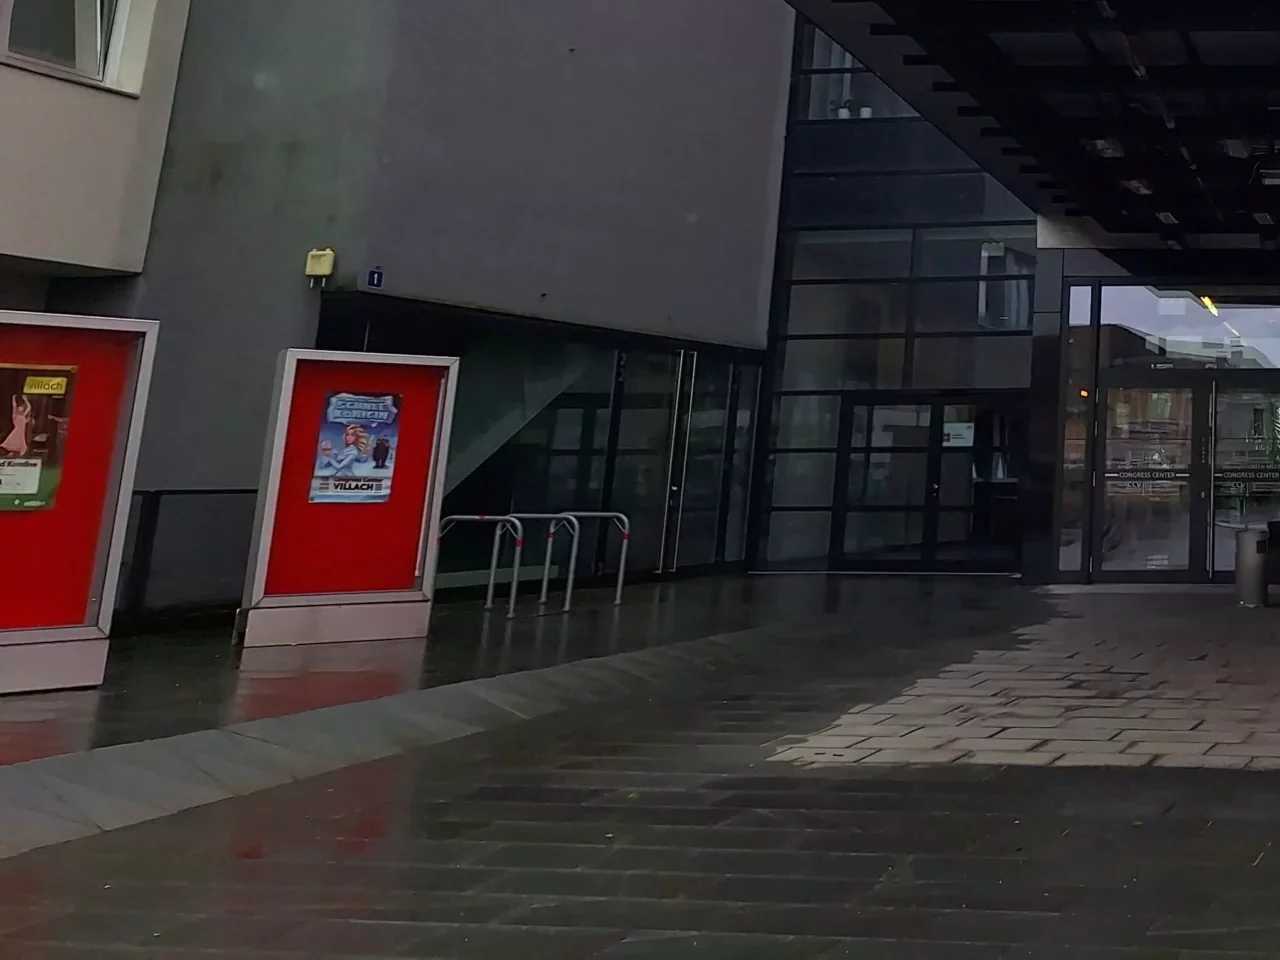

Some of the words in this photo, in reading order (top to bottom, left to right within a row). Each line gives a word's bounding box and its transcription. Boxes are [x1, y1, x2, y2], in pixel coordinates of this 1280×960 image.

[1223, 471, 1255, 479] CONGRESS
[1256, 471, 1280, 479] CENTER
[333, 482, 374, 491] VILLACH
